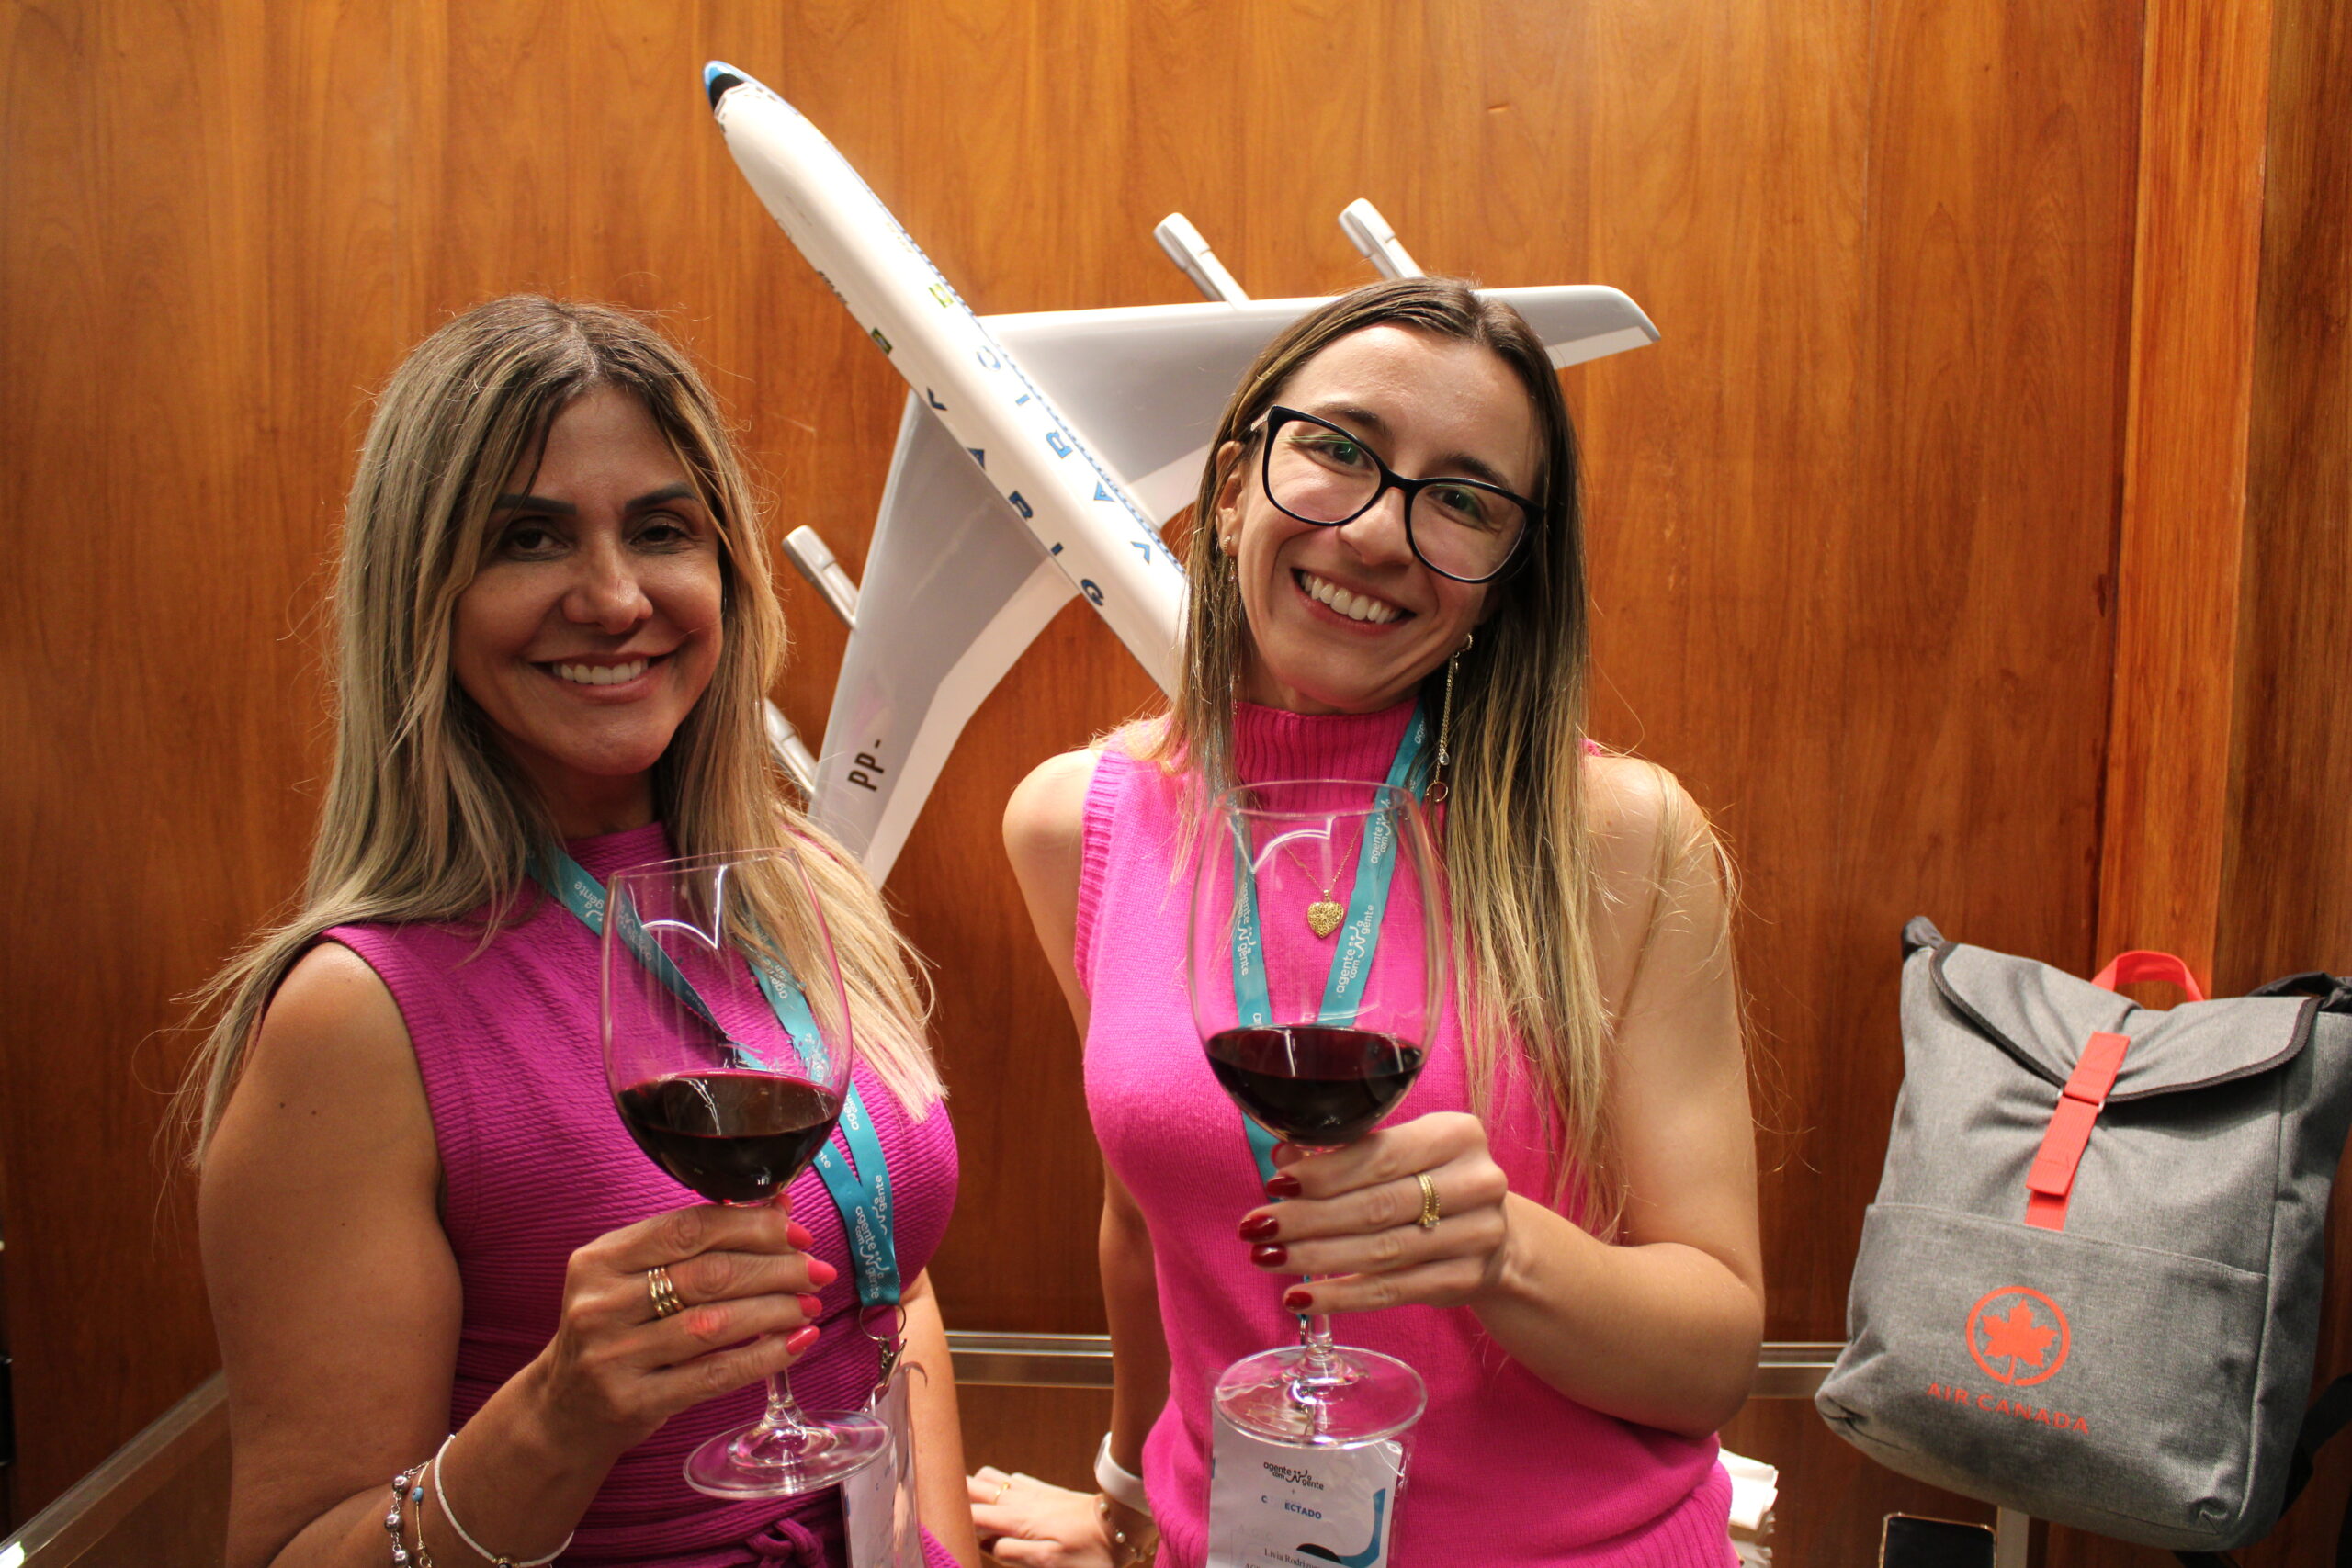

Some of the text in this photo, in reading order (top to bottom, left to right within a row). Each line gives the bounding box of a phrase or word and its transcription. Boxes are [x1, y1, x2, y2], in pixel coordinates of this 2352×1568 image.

[926, 386, 1104, 606] VARIG
[847, 739, 885, 792] PP-
[1371, 826, 1384, 863] agente
[1238, 942, 1249, 976] gente
[1349, 959, 1360, 979] com
[1361, 904, 1374, 935] gente
[1336, 948, 1356, 994] agente
[876, 1175, 888, 1212] gente
[855, 1205, 876, 1251] agente
[1927, 1382, 2089, 1434] AIR CANADA
[1263, 1461, 1292, 1476] agente
[1272, 1472, 1285, 1480] com
[1302, 1478, 1325, 1491] gente
